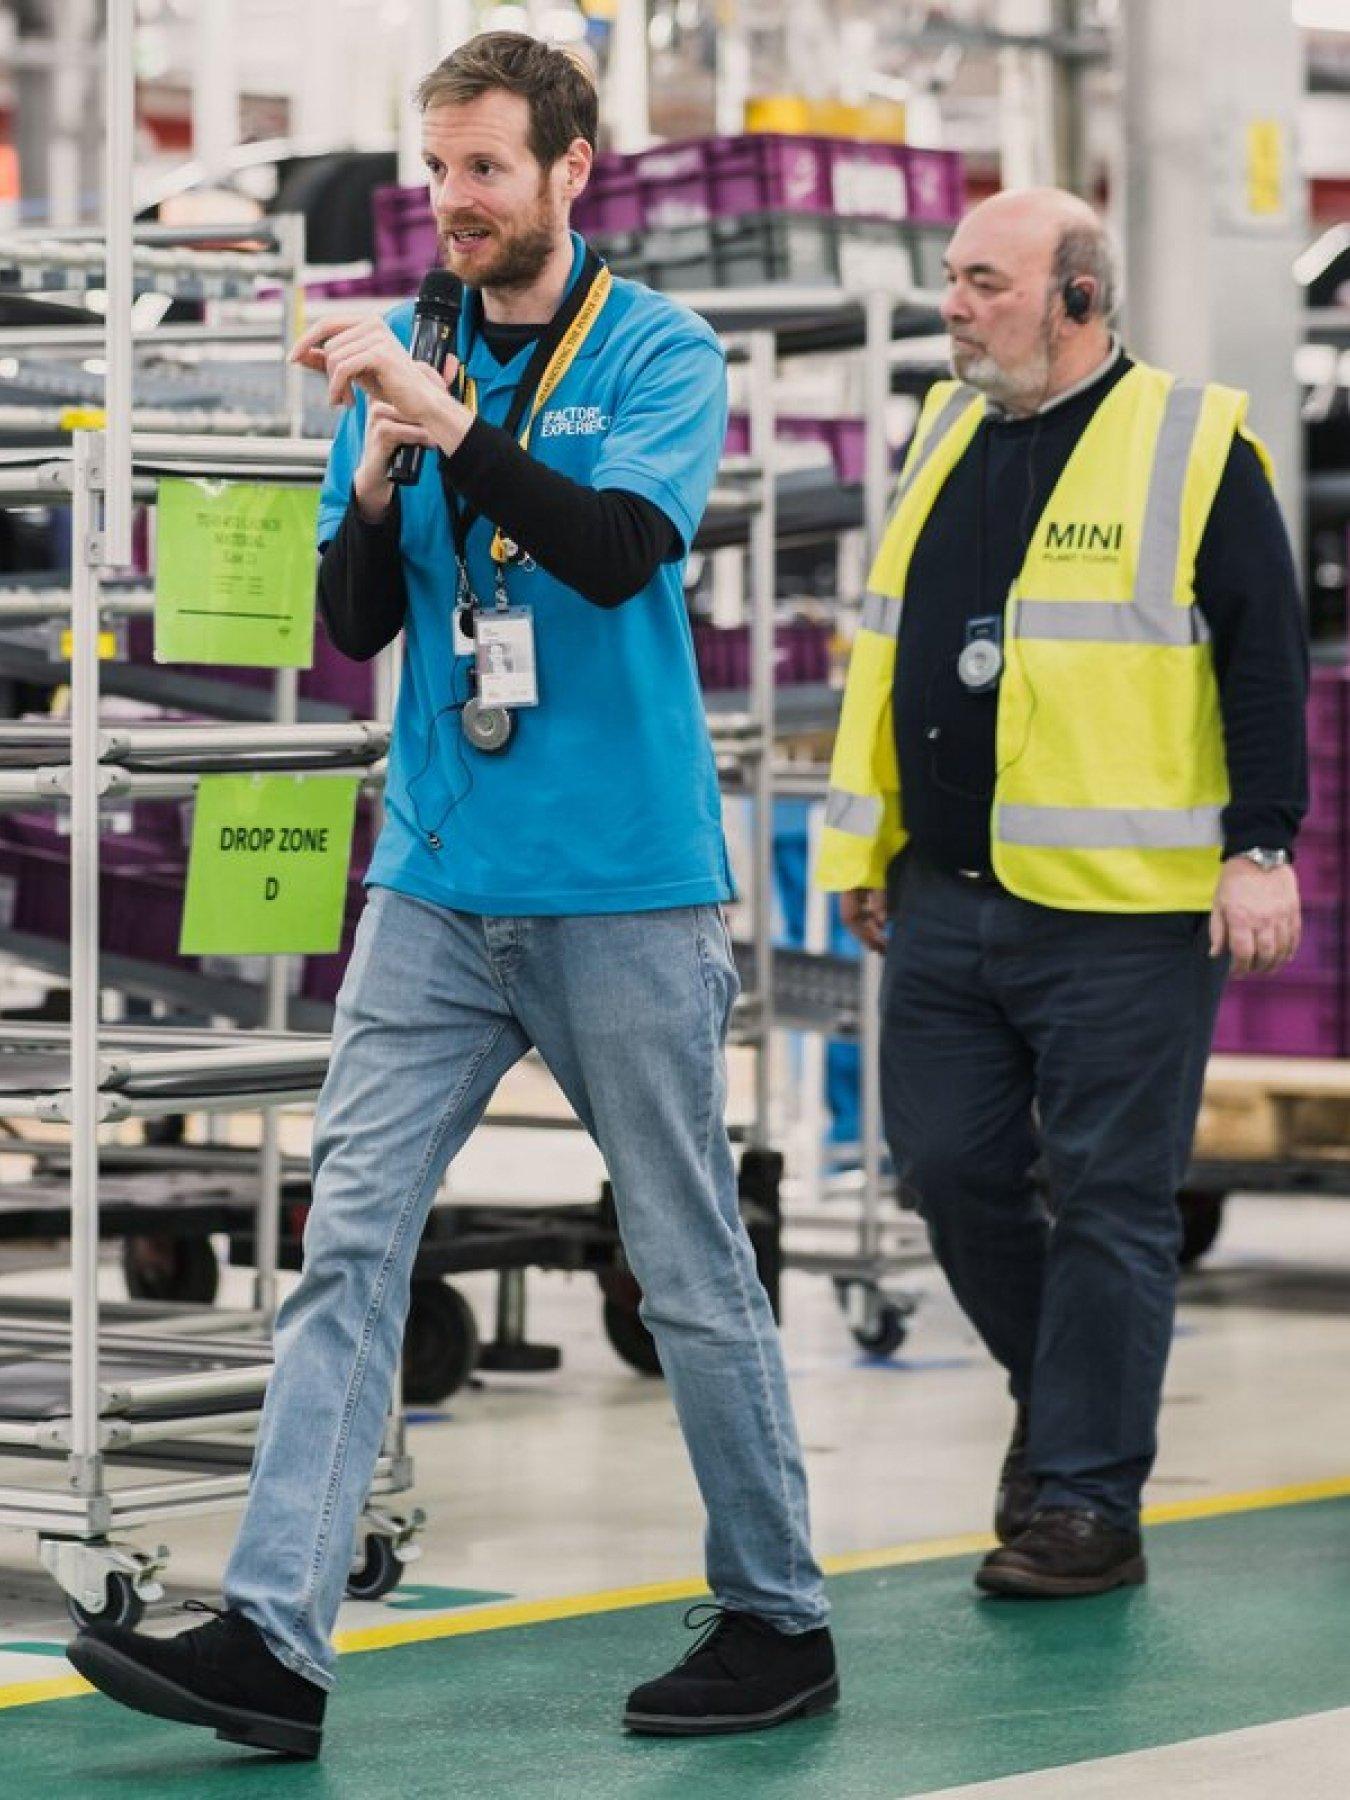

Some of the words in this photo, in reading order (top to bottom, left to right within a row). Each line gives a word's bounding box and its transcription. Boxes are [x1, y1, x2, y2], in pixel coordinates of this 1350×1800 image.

[1045, 523, 1123, 550] MINI
[220, 827, 275, 852] DROP
[279, 828, 329, 852] ZONE
[265, 877, 279, 900] D
